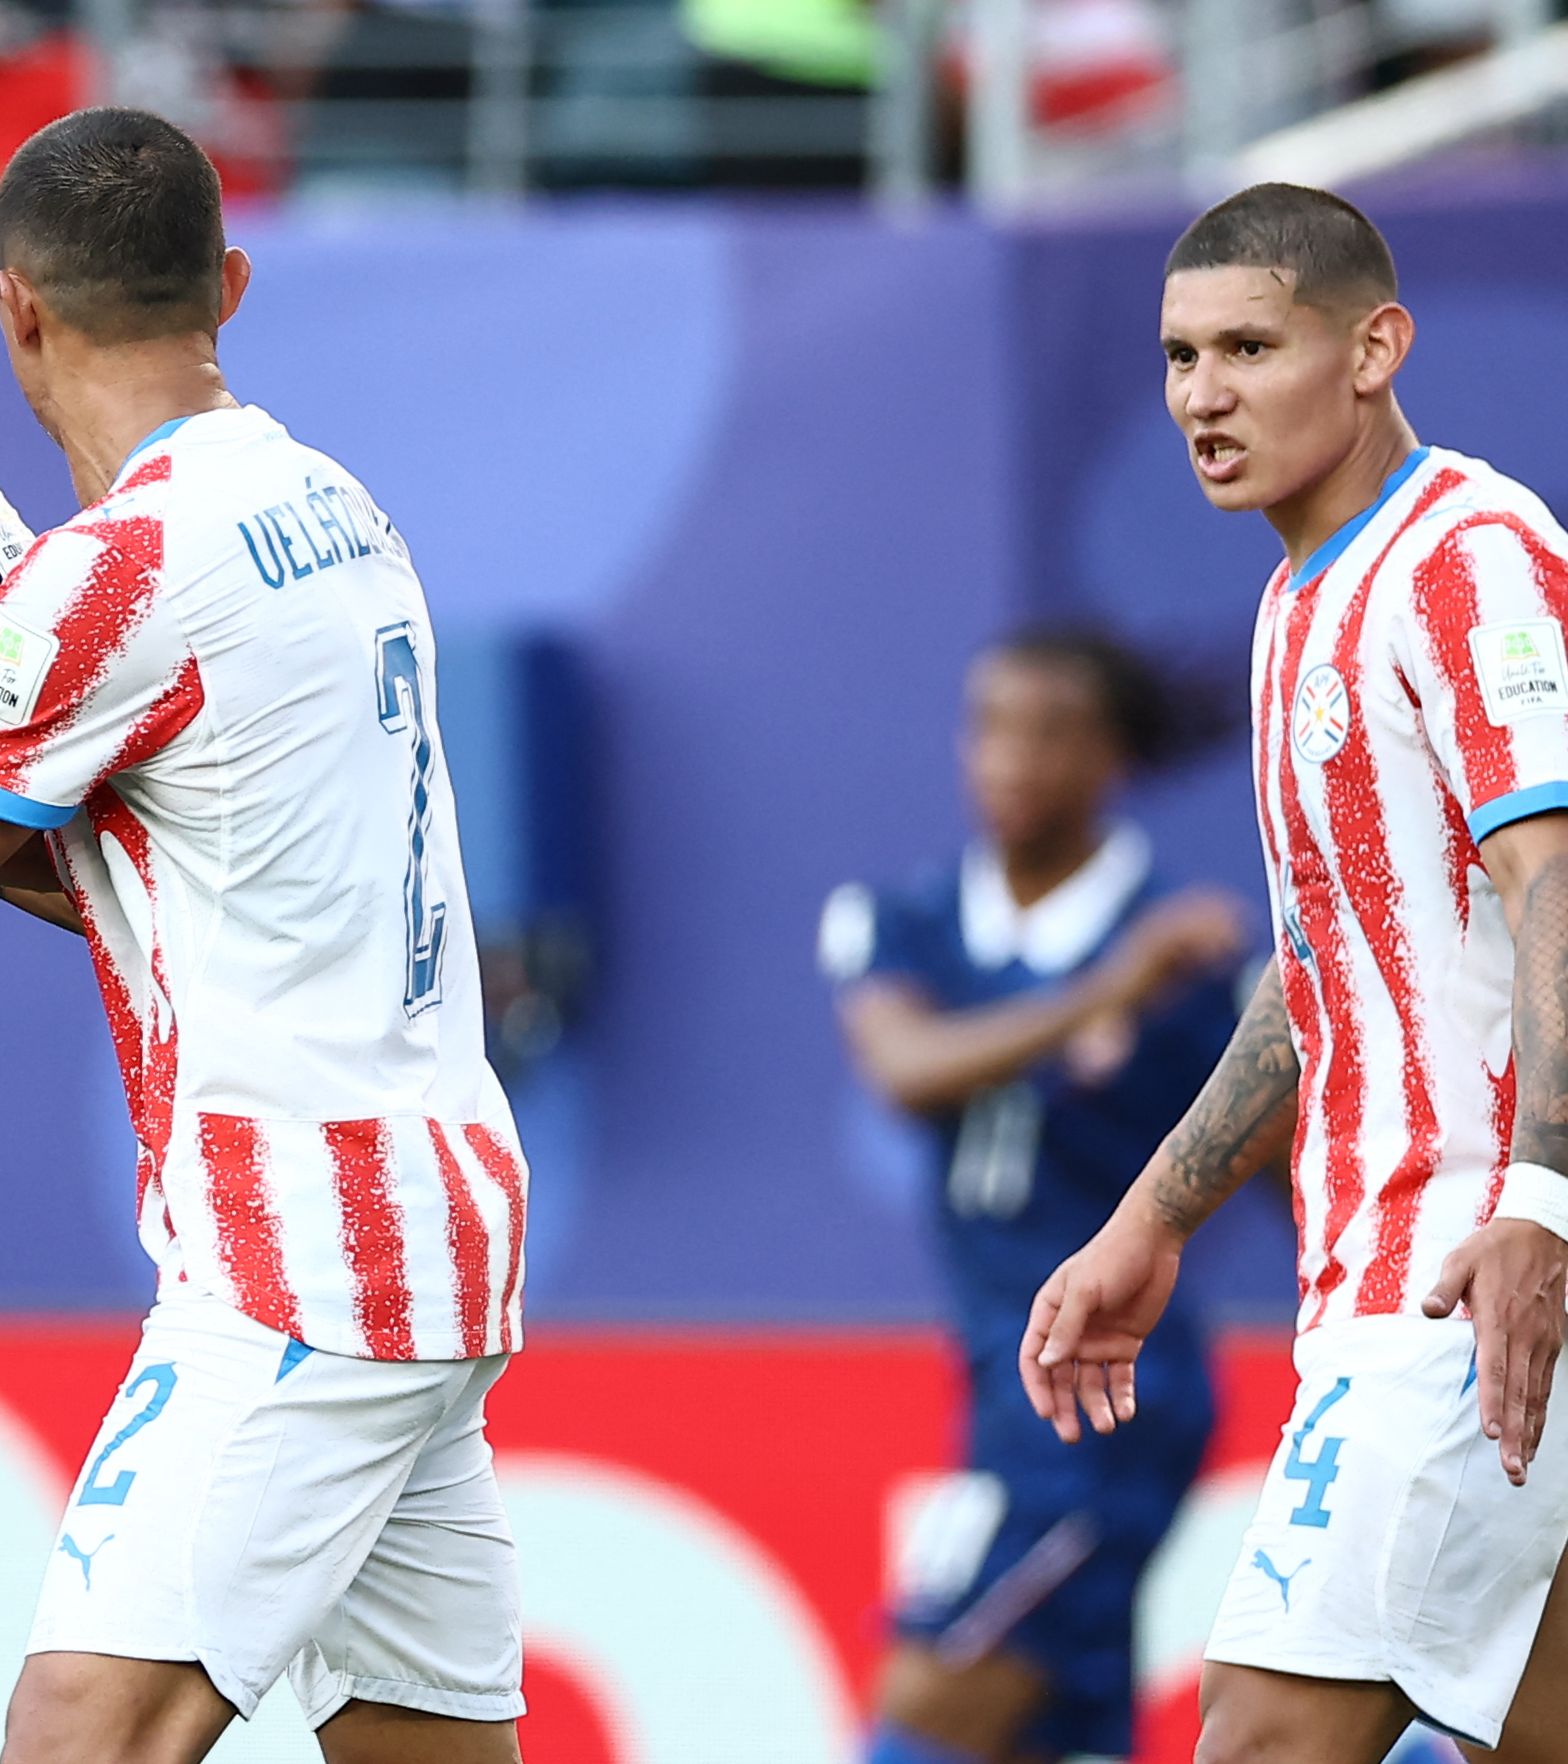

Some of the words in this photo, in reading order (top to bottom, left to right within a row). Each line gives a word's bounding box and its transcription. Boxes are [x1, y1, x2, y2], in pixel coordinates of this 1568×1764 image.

[1498, 680, 1558, 700] EDUCATION
[375, 621, 447, 1020] 2
[77, 1361, 178, 1507] 2
[1284, 1377, 1353, 1529] 4
